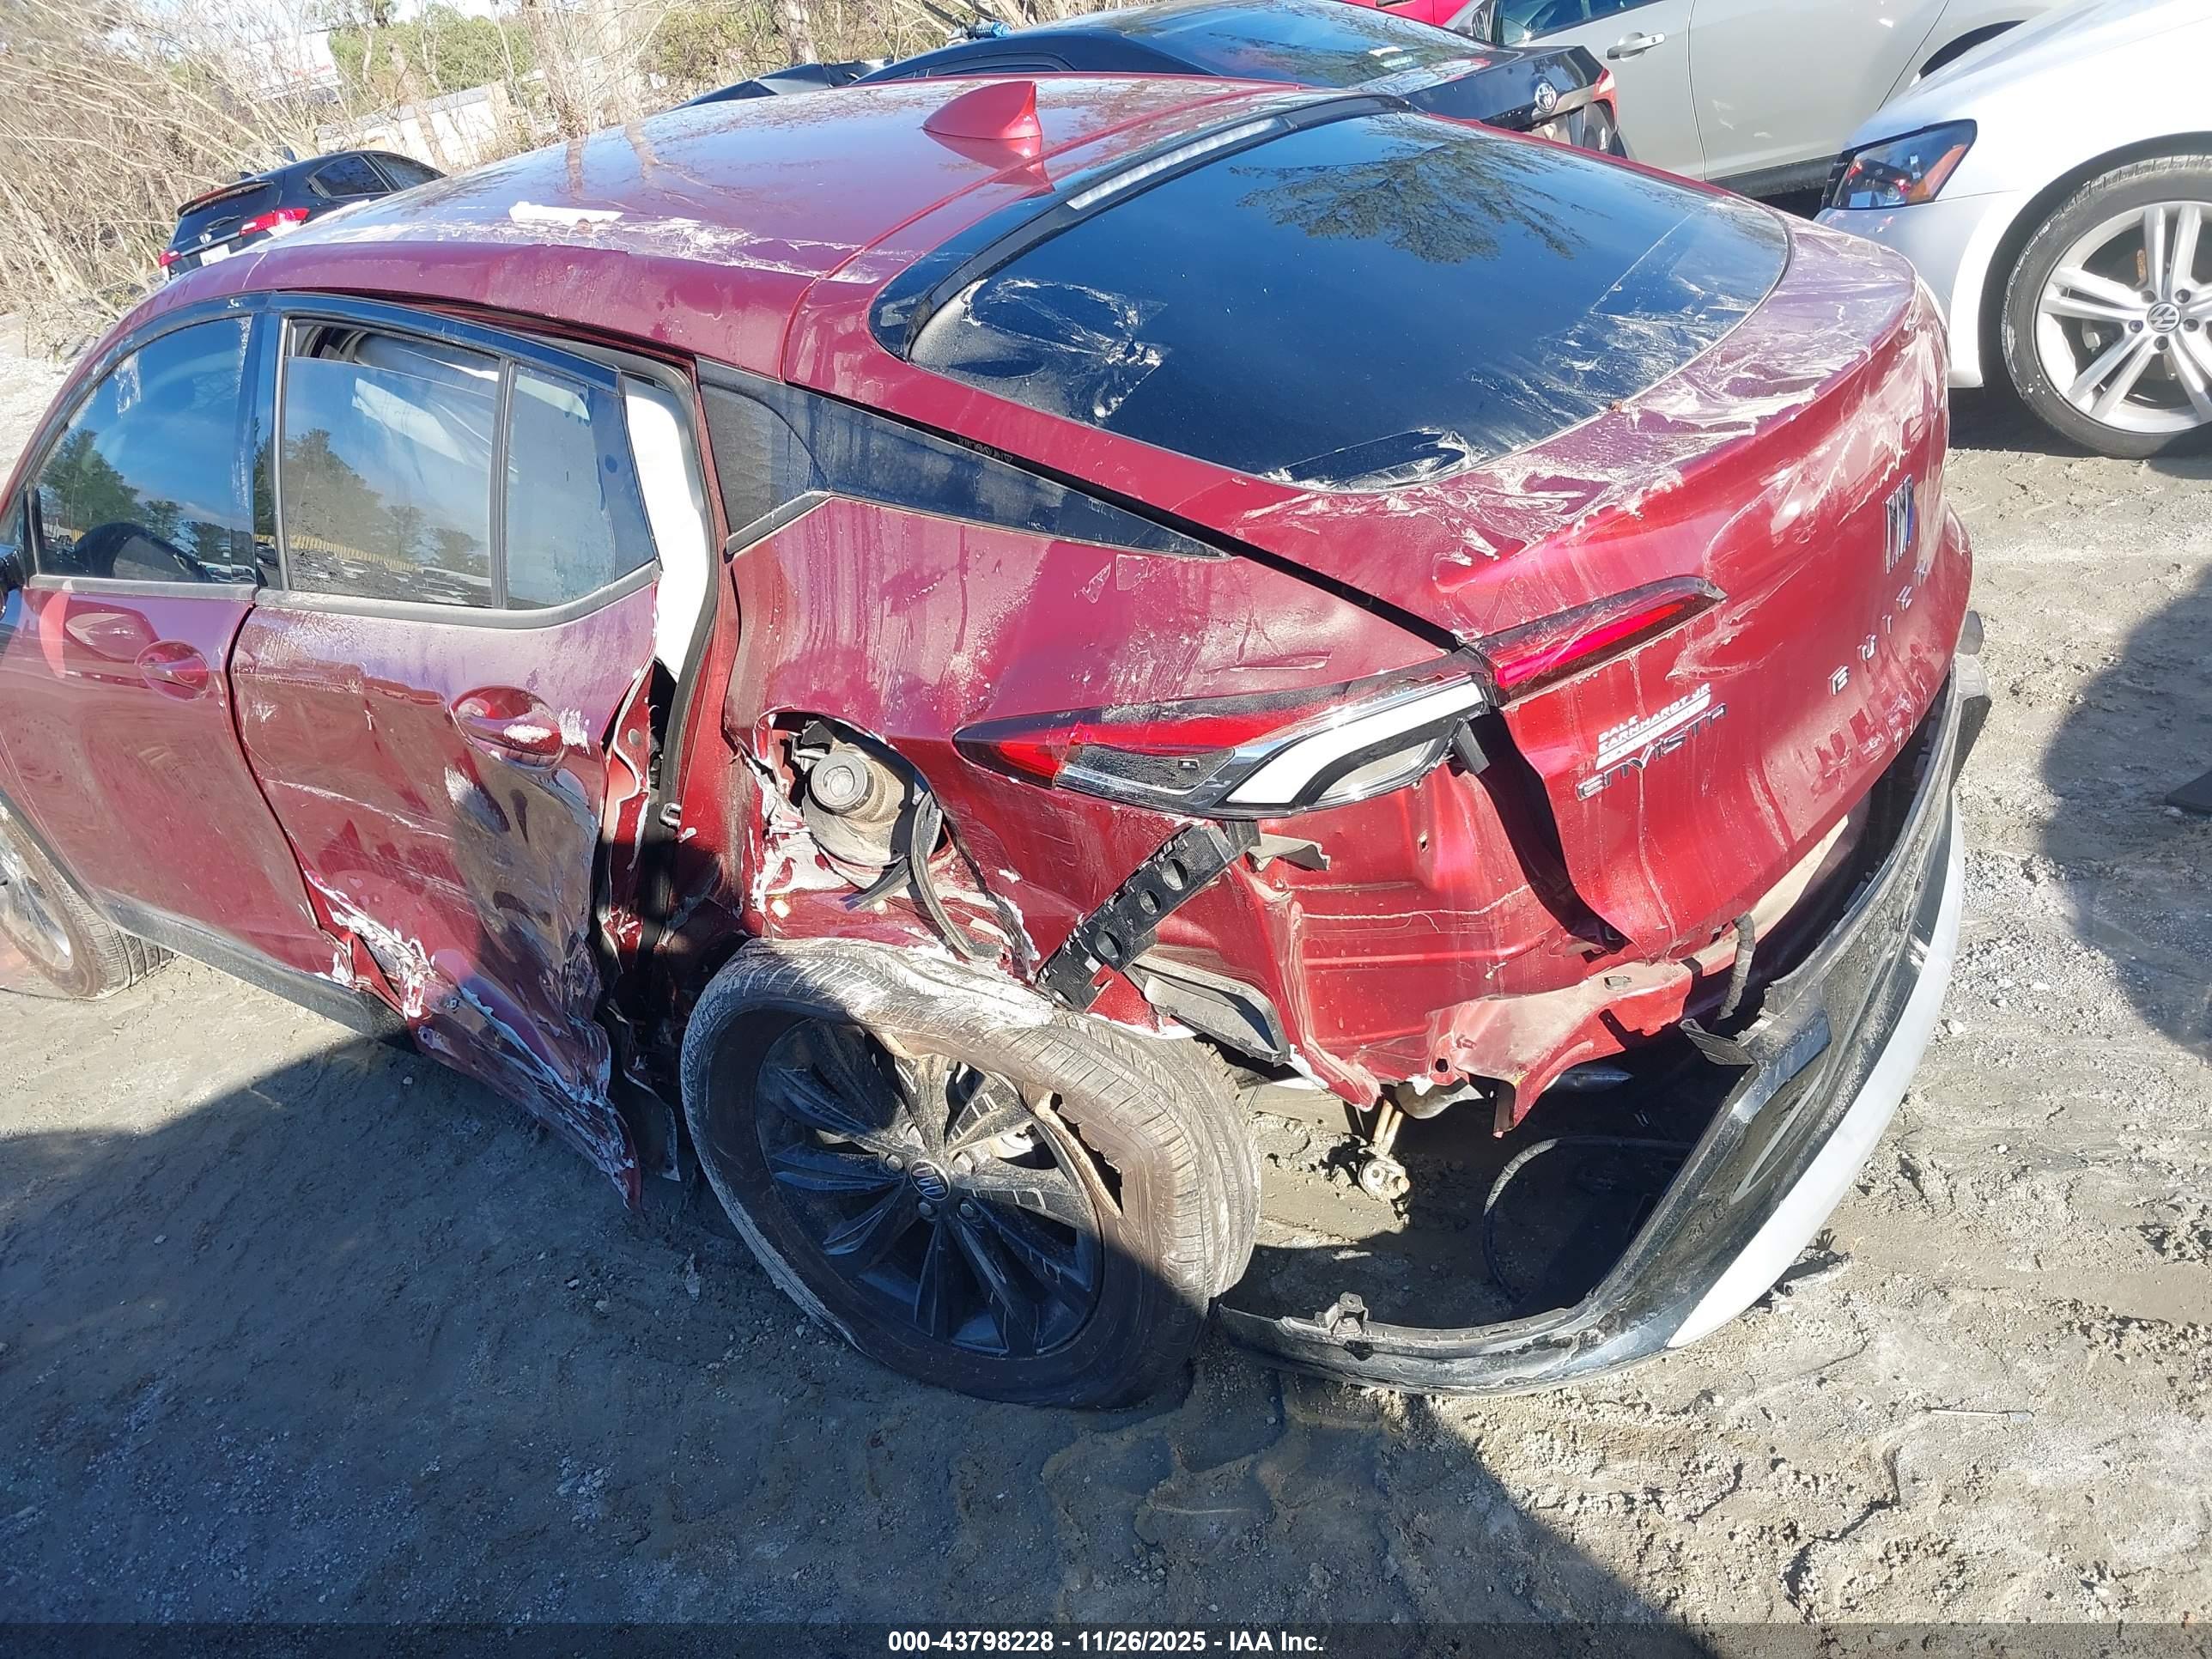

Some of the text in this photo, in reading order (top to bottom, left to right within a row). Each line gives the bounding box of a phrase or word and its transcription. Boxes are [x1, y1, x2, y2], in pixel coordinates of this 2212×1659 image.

[1598, 696, 1689, 753] EARNHARDT
[1692, 683, 1711, 696] JR
[1598, 714, 1639, 743] DALE
